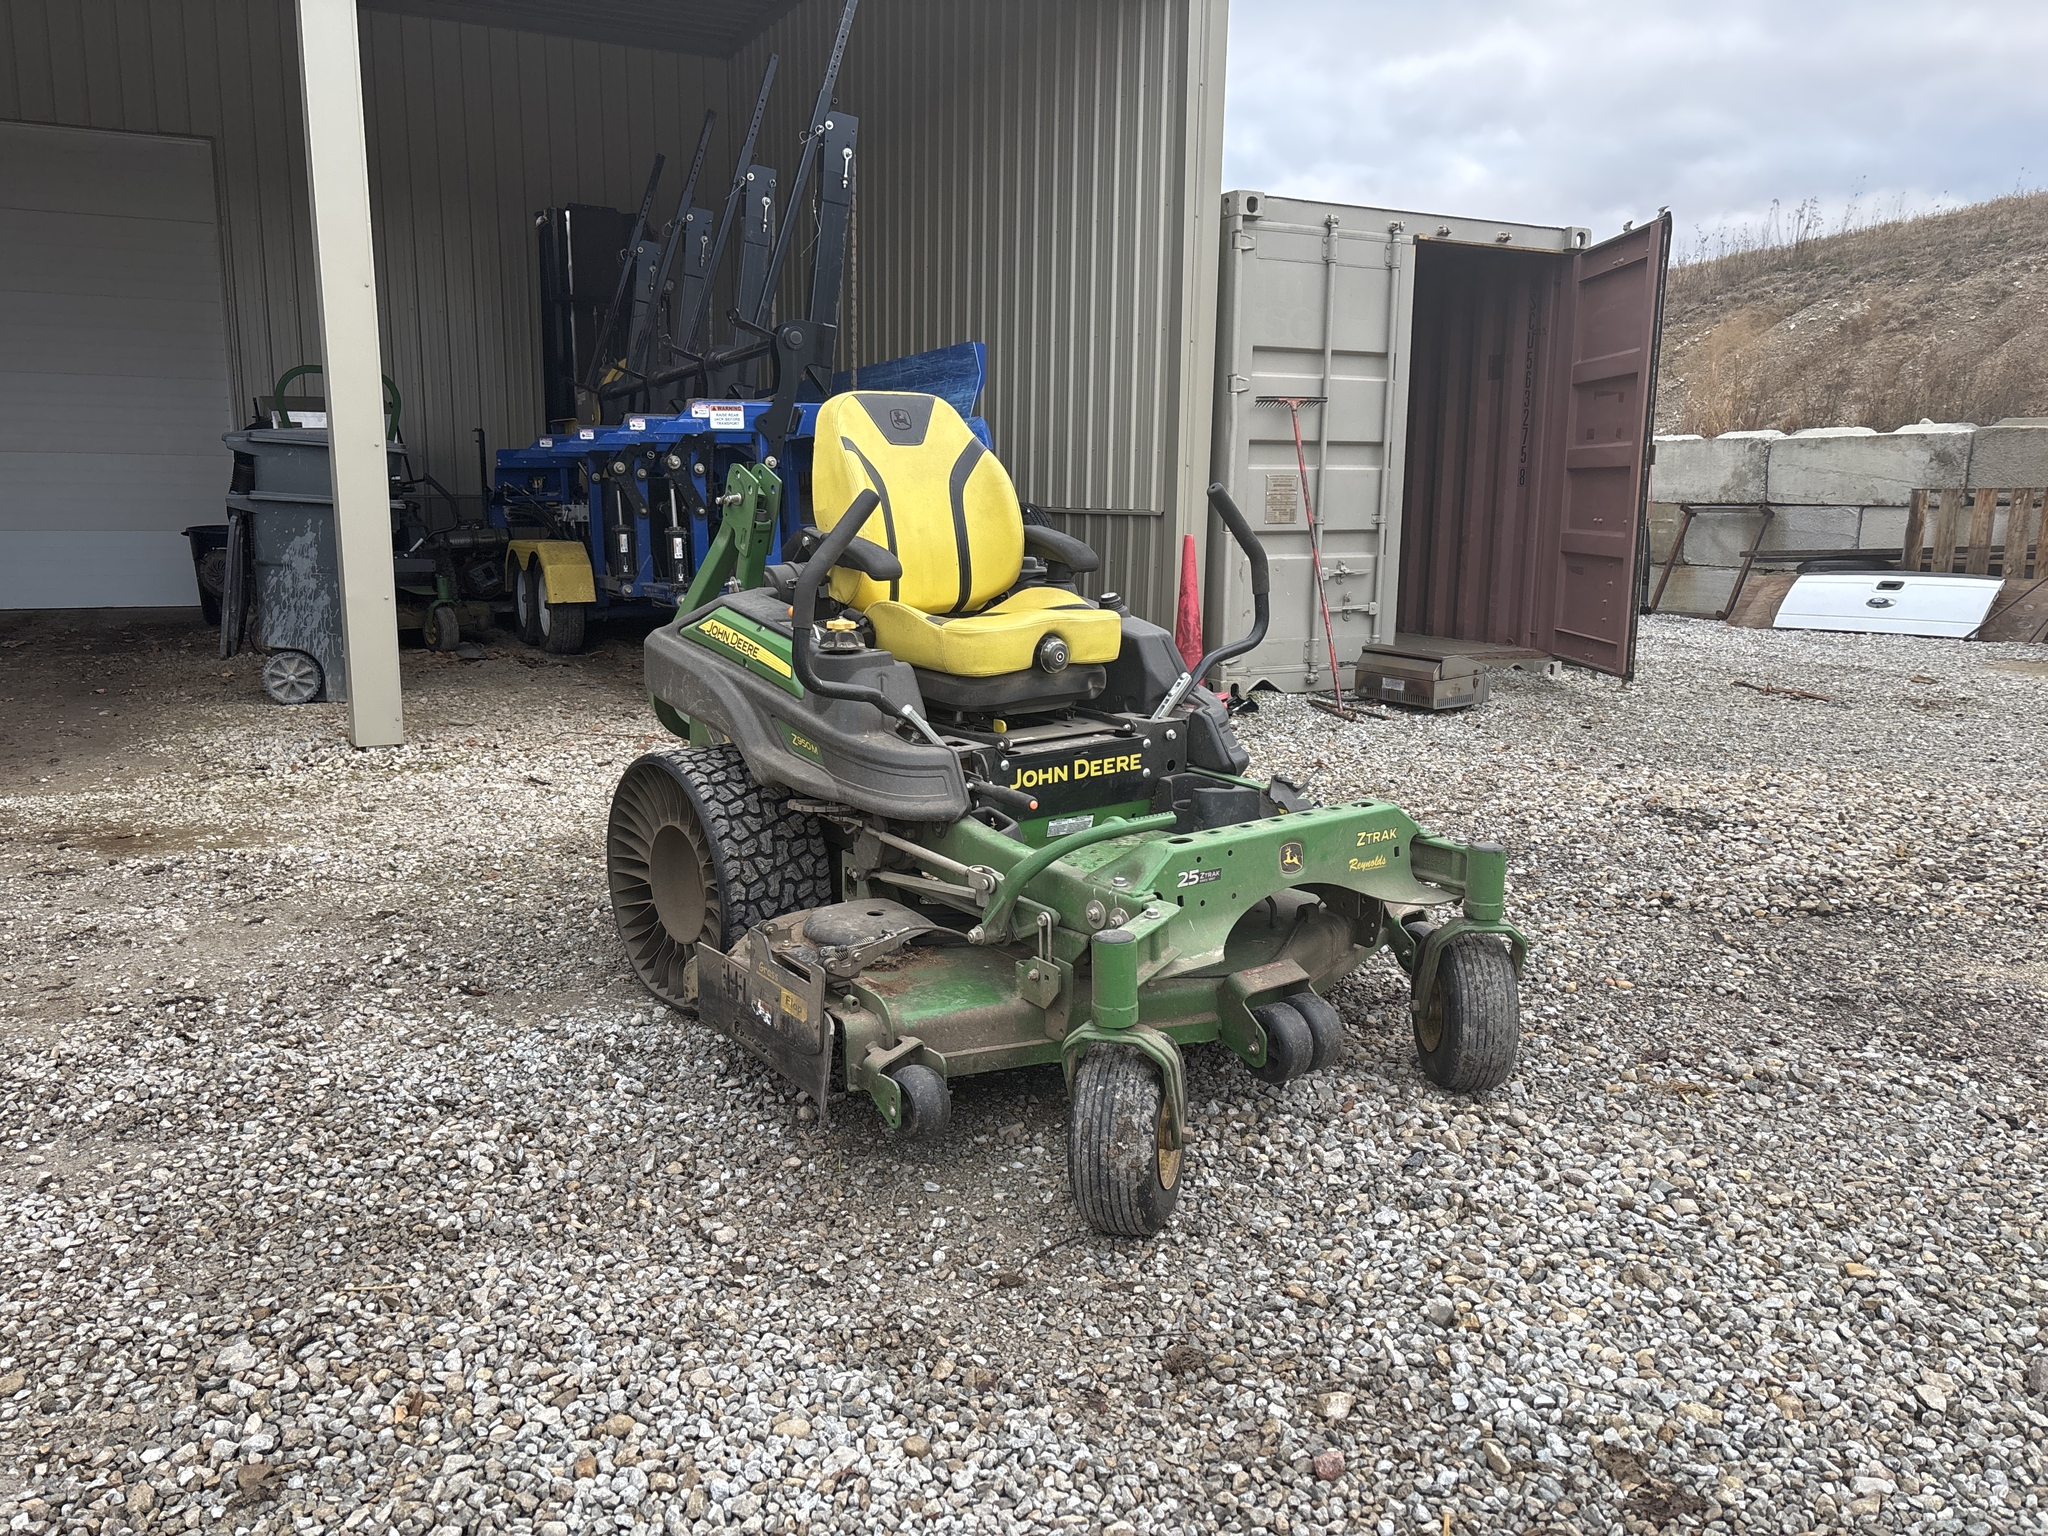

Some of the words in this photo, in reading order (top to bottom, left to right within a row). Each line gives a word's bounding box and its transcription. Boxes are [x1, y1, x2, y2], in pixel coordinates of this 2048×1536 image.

[706, 622, 730, 644] JOHN
[729, 632, 760, 659] DEERE
[790, 732, 819, 756] Z950M
[1009, 764, 1068, 790] JOHN
[1073, 753, 1142, 780] DEERE
[1356, 827, 1398, 847] ZTRAK
[1348, 854, 1387, 872] Reynolds
[1177, 869, 1200, 888] 25
[1199, 870, 1220, 880] ZTRAK
[758, 961, 779, 981] Grass
[785, 995, 803, 1014] Flap
